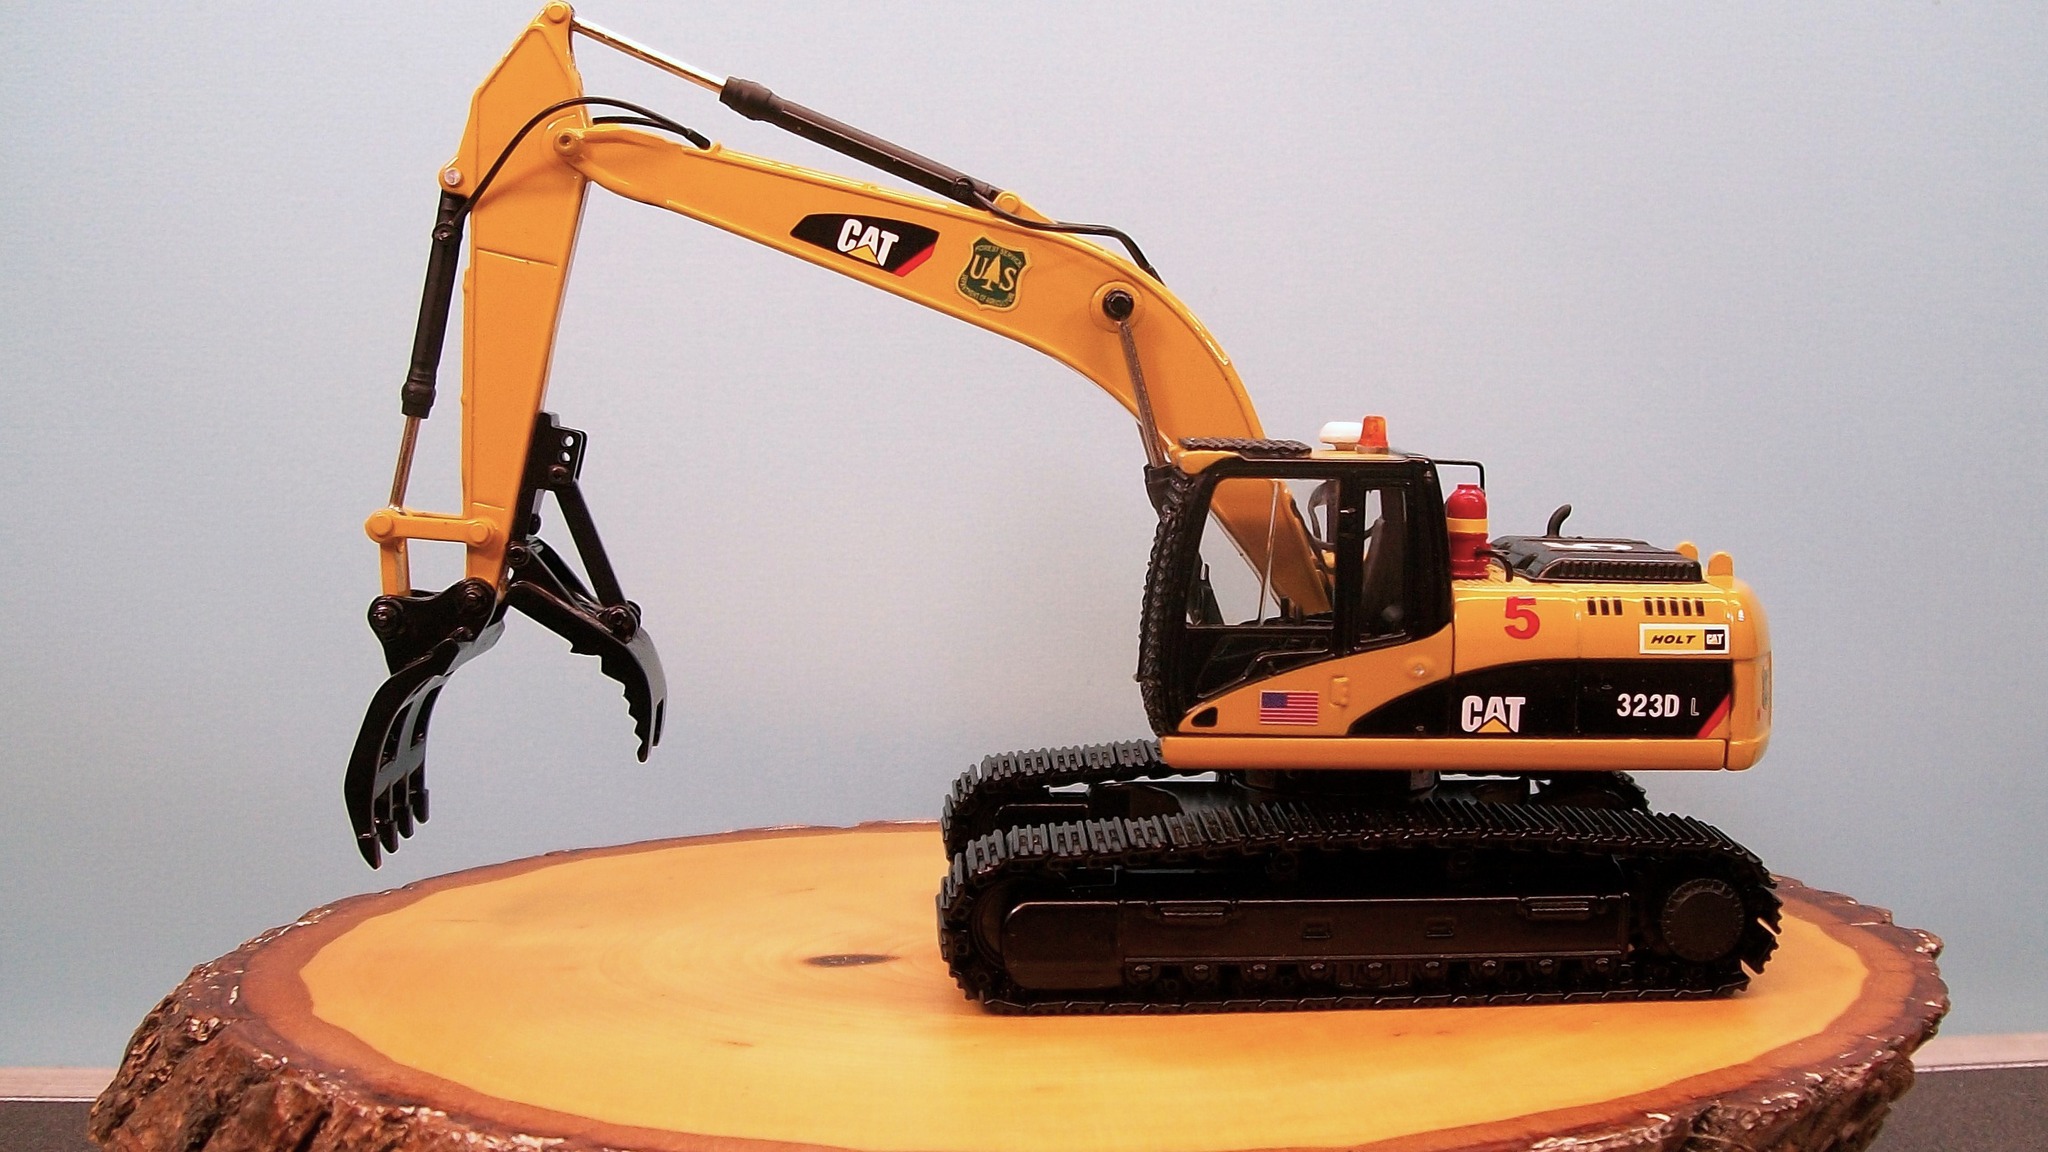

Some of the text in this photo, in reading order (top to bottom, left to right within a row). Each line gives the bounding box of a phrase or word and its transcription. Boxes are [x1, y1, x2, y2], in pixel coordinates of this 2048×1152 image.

[837, 218, 900, 267] CAT
[1504, 596, 1541, 640] 5
[1650, 633, 1724, 645] HOLT CAT
[1461, 695, 1526, 733] CAT
[1616, 693, 1700, 718] 323D L
